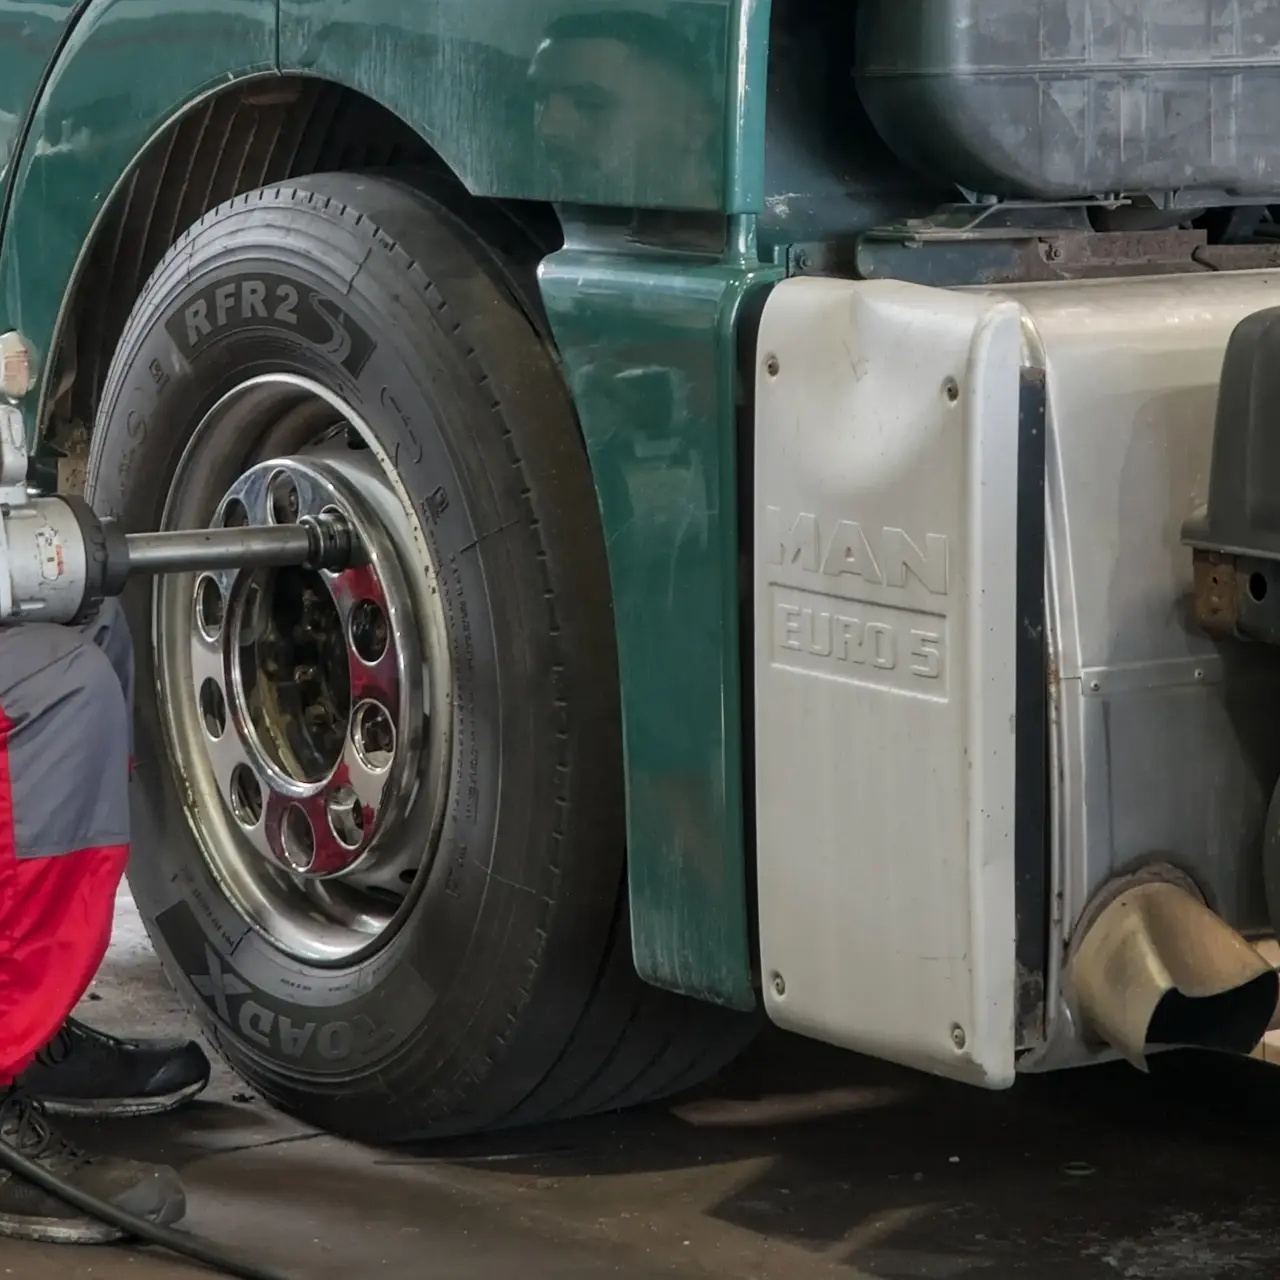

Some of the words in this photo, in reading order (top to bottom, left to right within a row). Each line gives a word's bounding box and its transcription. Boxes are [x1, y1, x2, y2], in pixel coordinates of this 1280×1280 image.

[183, 280, 300, 348] RFR2
[766, 505, 949, 596] MAN
[776, 603, 896, 670] EURO
[910, 629, 941, 679] 5
